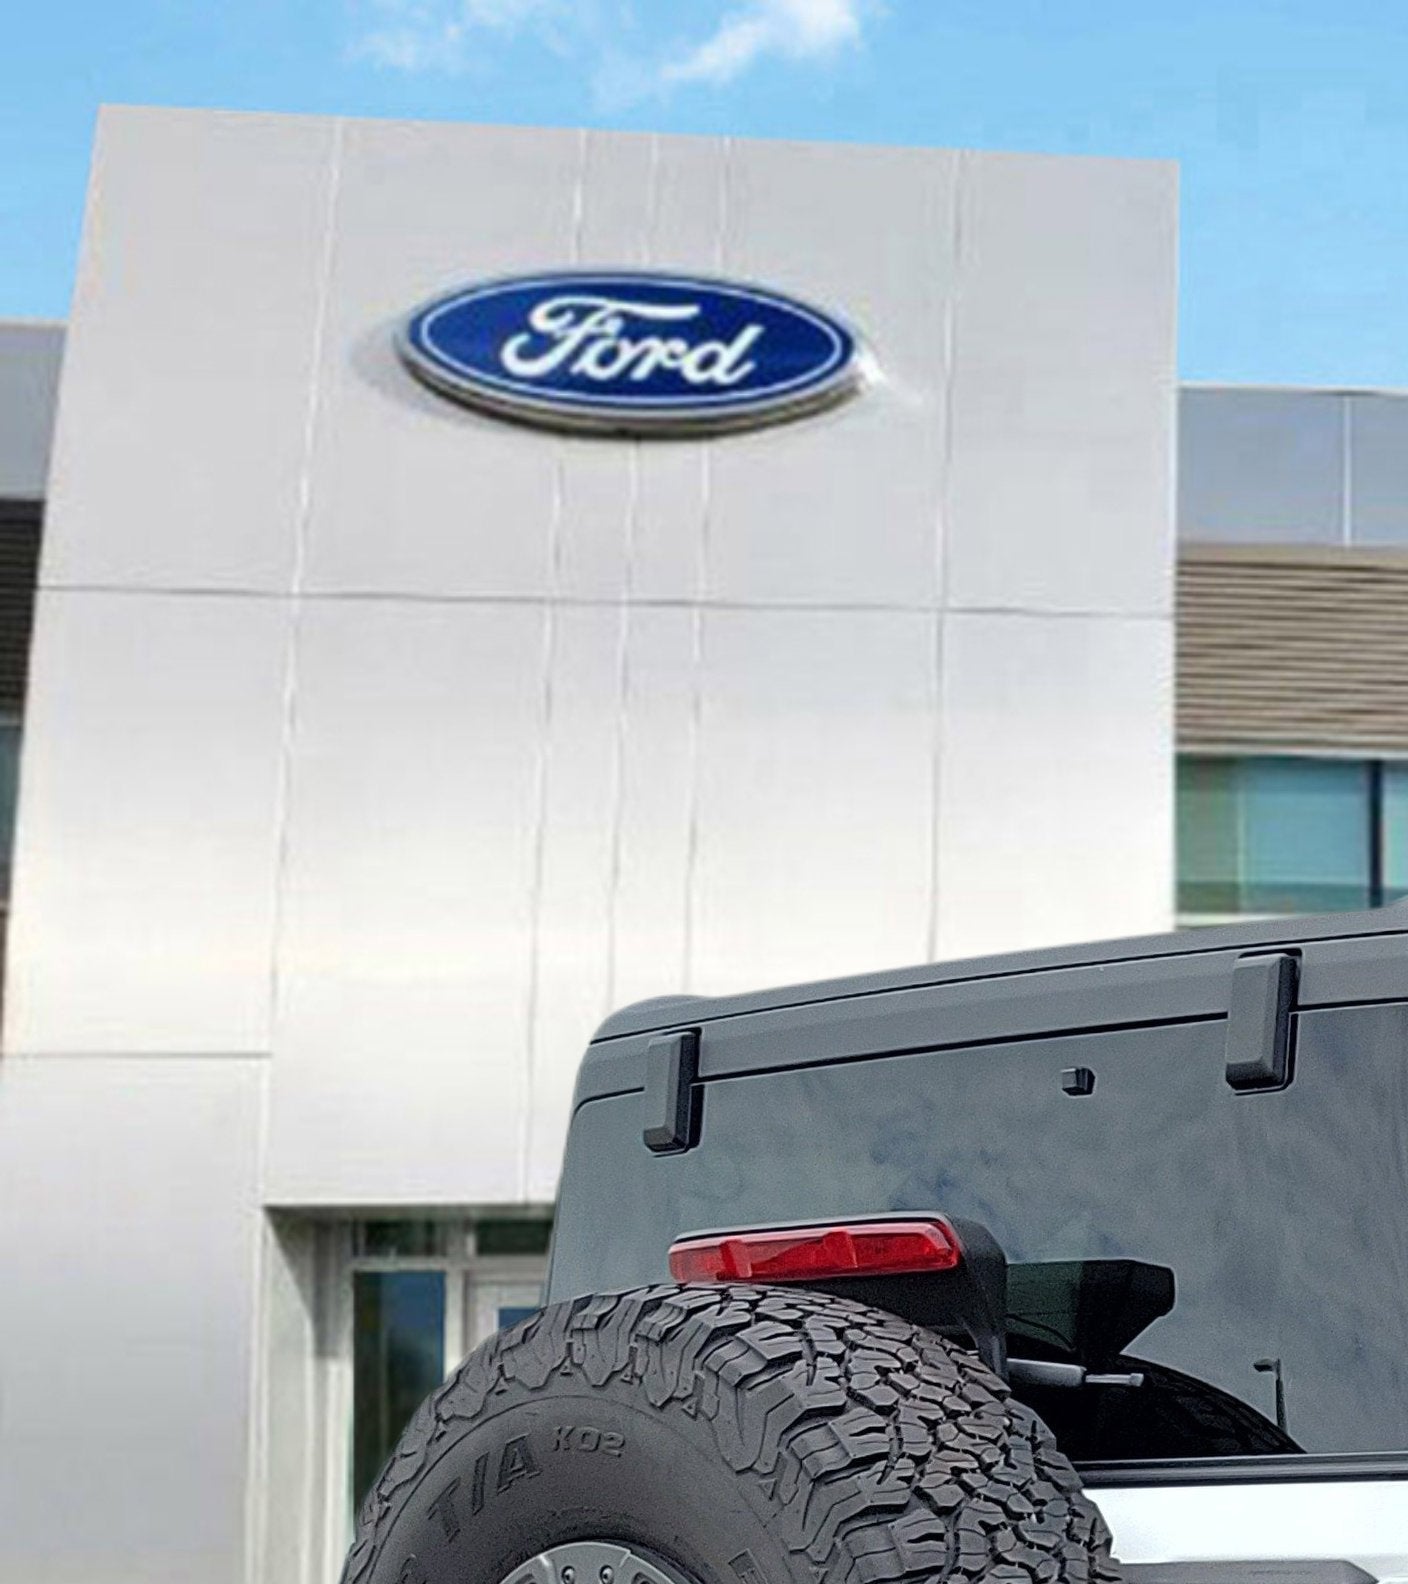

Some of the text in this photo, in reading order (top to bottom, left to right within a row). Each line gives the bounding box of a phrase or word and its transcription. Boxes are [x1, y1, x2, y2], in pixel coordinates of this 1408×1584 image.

[500, 294, 765, 386] Ford
[426, 1432, 542, 1544] T/A
[551, 1424, 627, 1458] KO2
